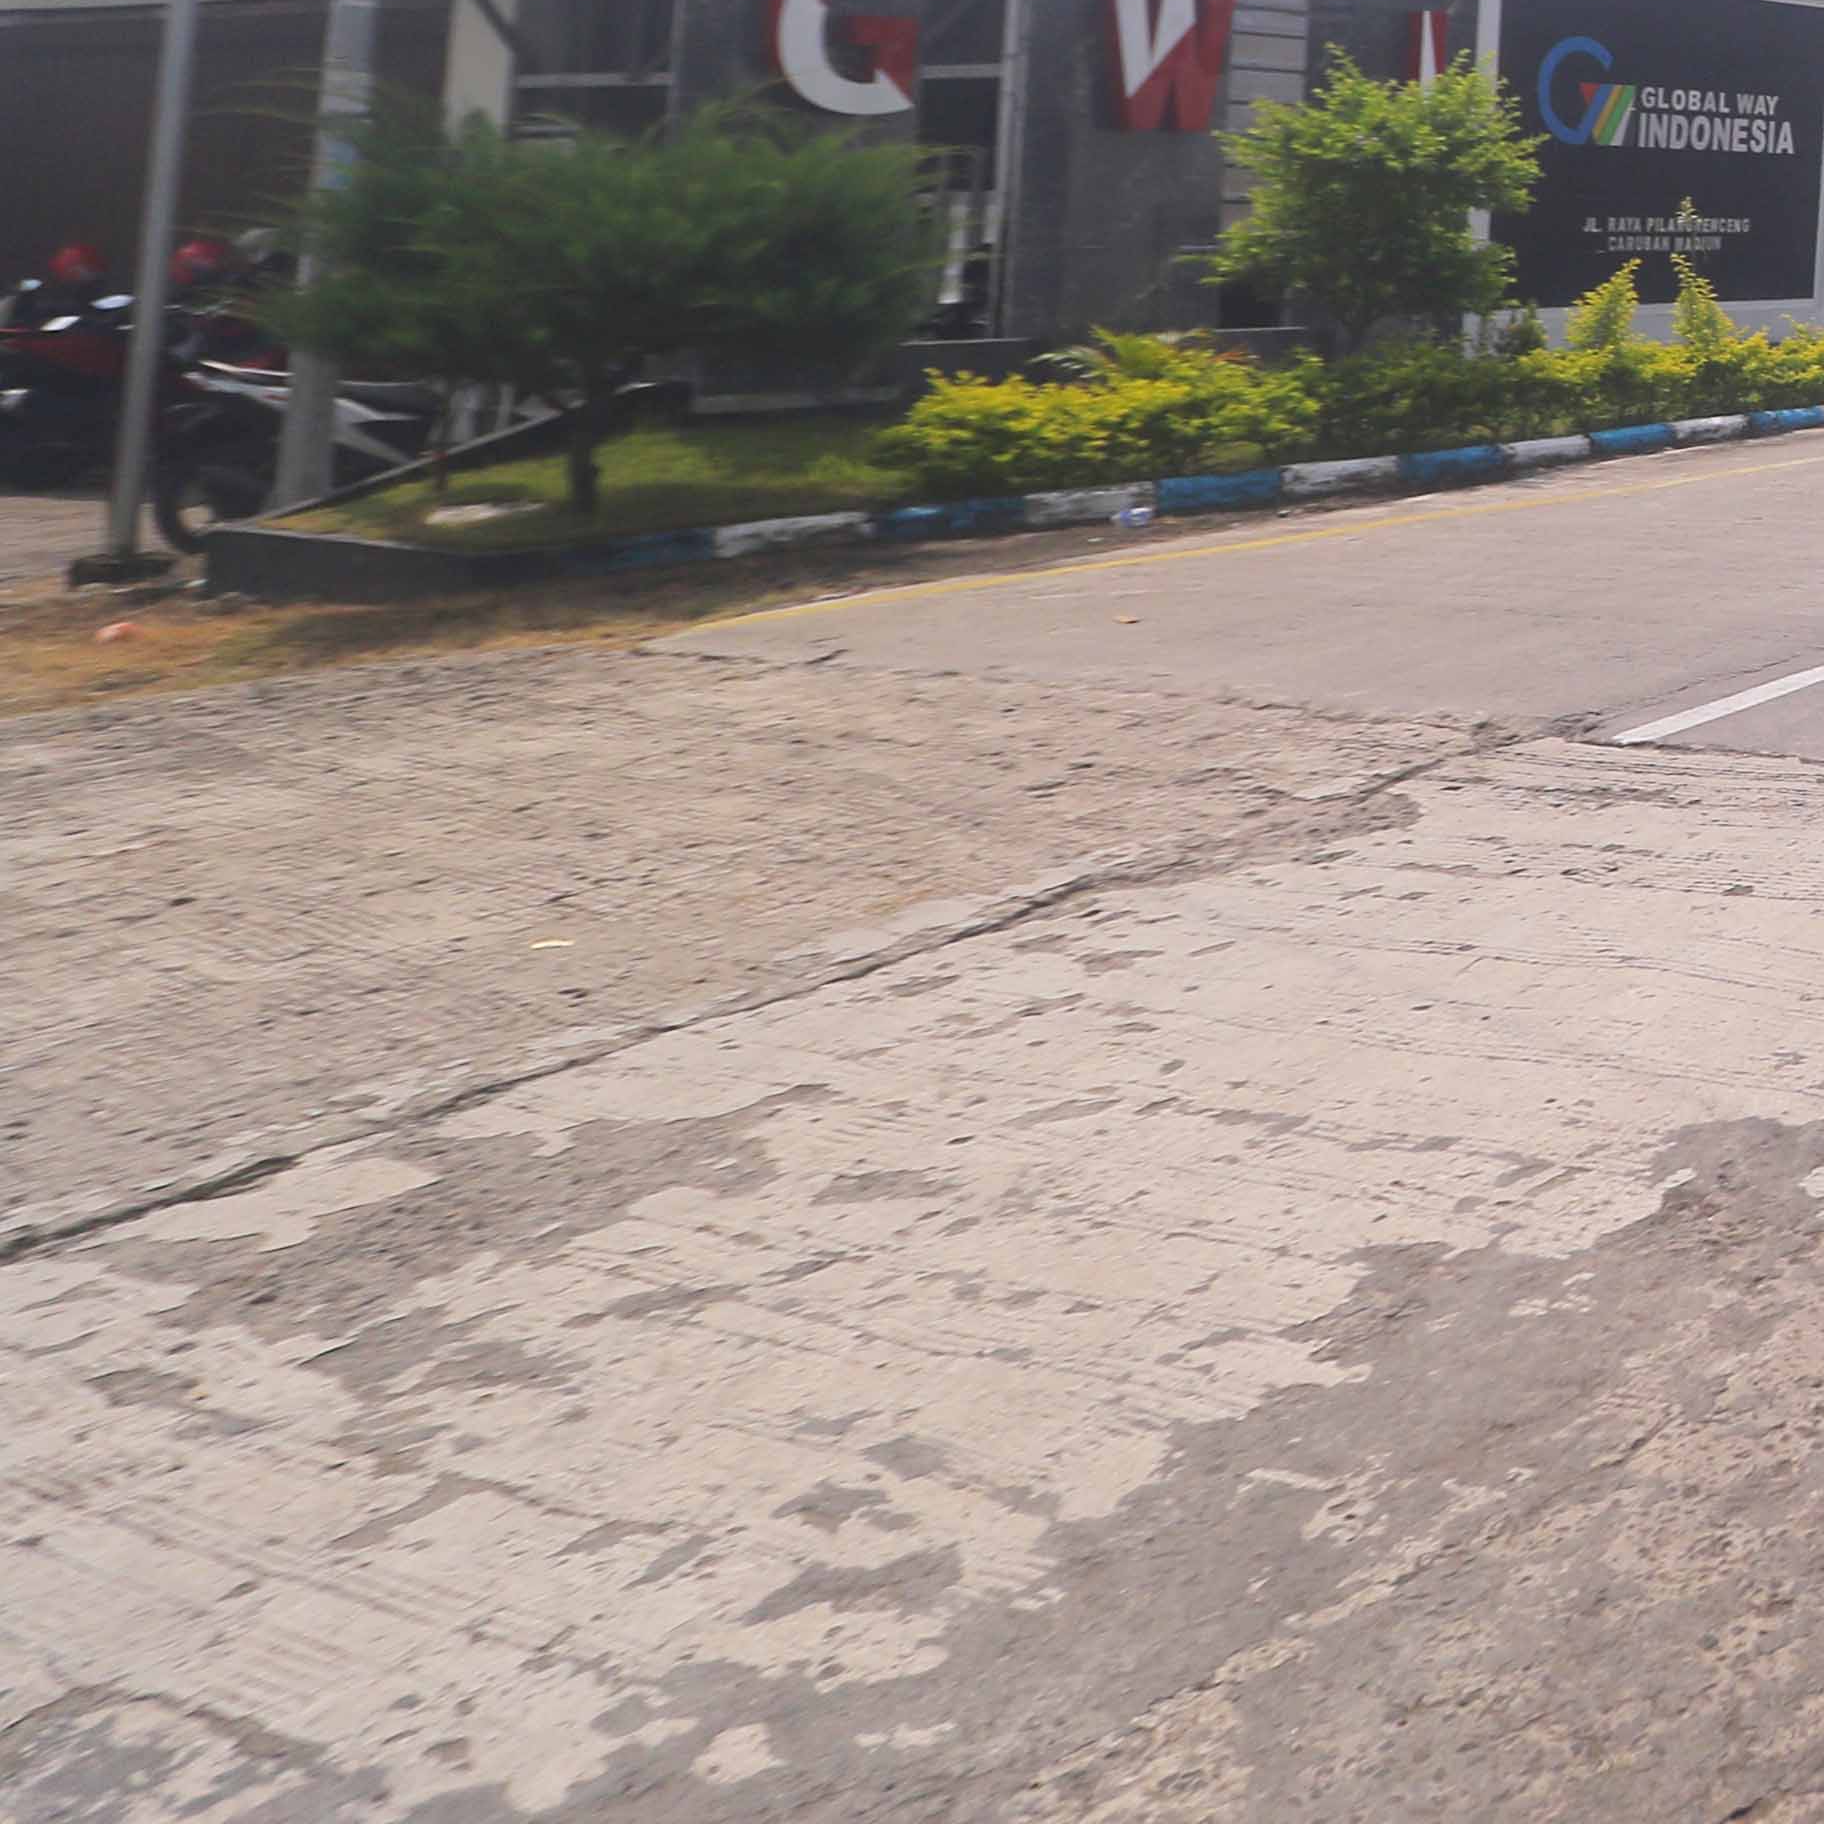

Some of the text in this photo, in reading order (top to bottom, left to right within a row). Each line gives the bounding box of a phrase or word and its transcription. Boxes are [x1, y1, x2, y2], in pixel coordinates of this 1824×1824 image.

[1640, 86, 1780, 116] GLOBAL WAY
[1637, 113, 1795, 155] INDONESIA
[1608, 217, 1642, 233] RAYA
